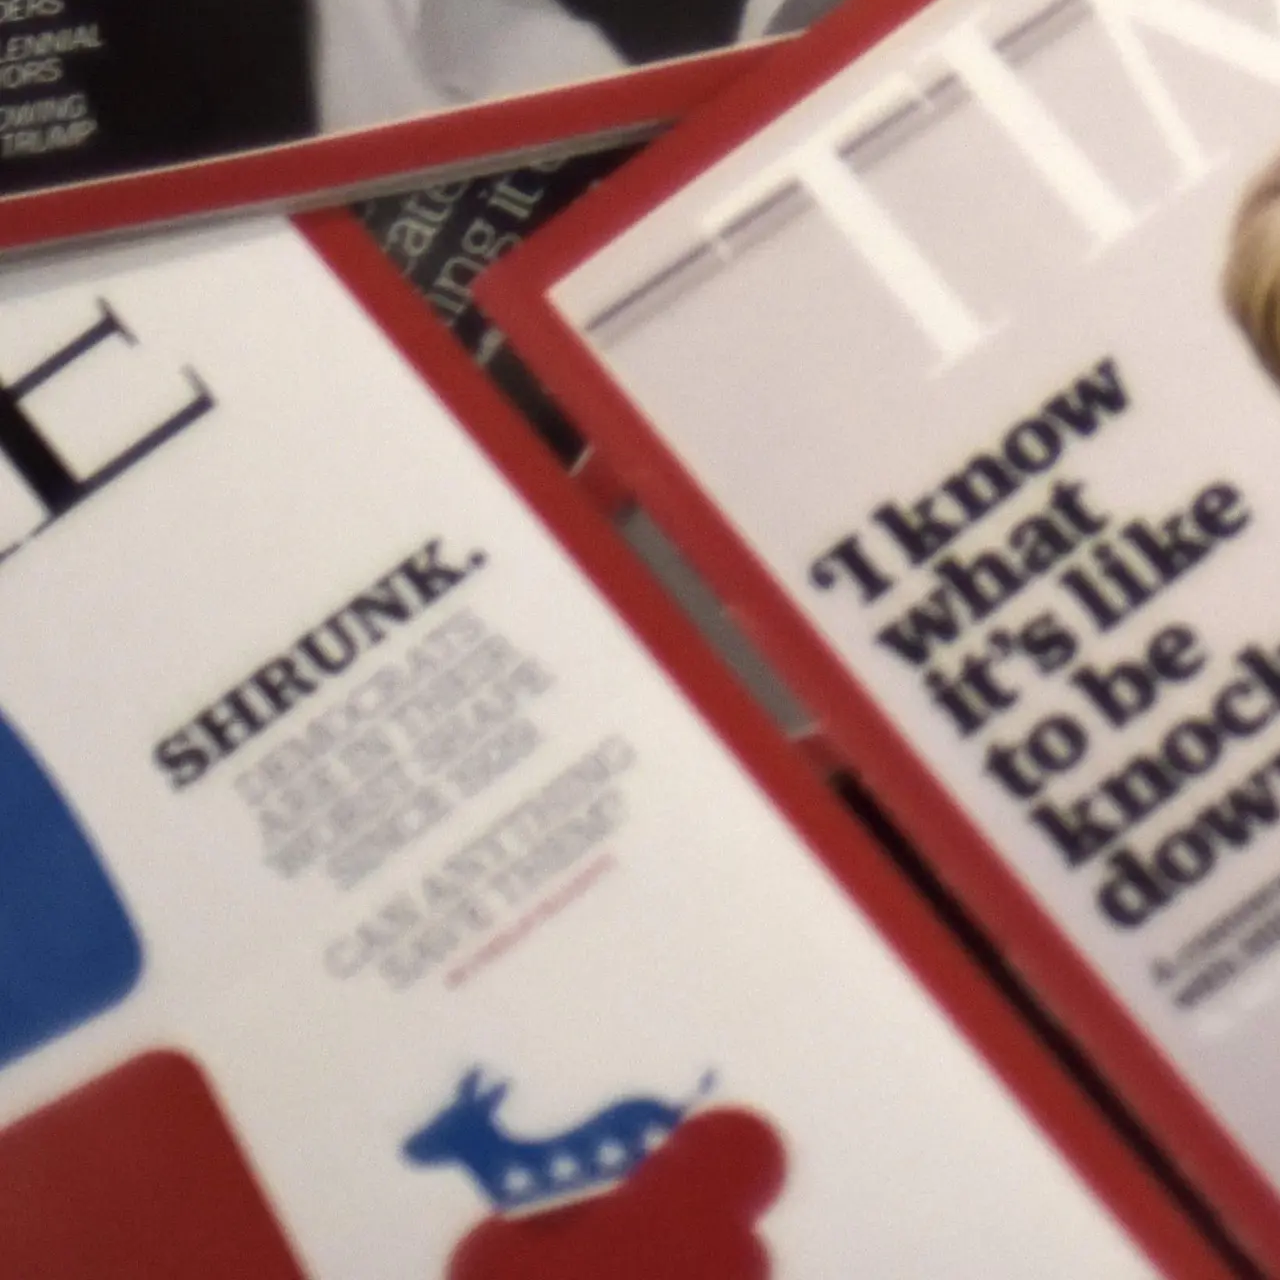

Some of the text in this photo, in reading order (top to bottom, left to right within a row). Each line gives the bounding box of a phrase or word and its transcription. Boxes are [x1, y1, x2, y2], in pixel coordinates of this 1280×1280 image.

[872, 356, 1132, 566] know
[152, 536, 490, 790] SHRUNK.
[876, 476, 1110, 670] what
[921, 479, 1254, 739] it's like
[983, 623, 1209, 801] to be
